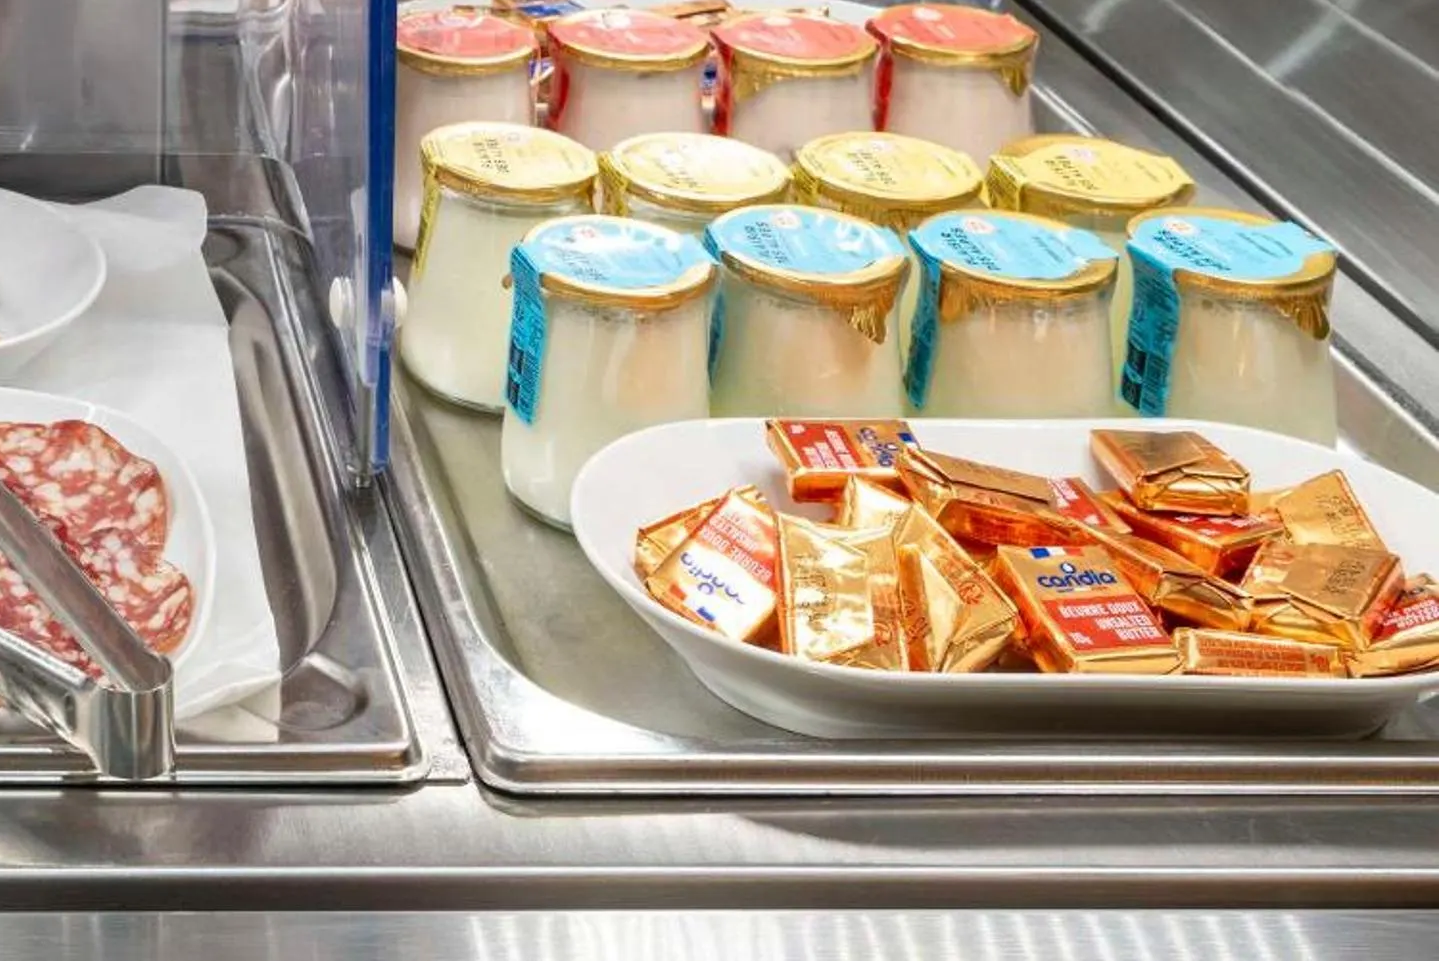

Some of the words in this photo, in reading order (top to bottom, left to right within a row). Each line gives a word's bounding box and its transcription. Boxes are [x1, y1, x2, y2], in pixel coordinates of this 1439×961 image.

[1037, 569, 1117, 588] candia
[1058, 603, 1107, 618] BEURRE
[1107, 601, 1143, 615] DOUX
[1095, 615, 1153, 629] UNSALTED
